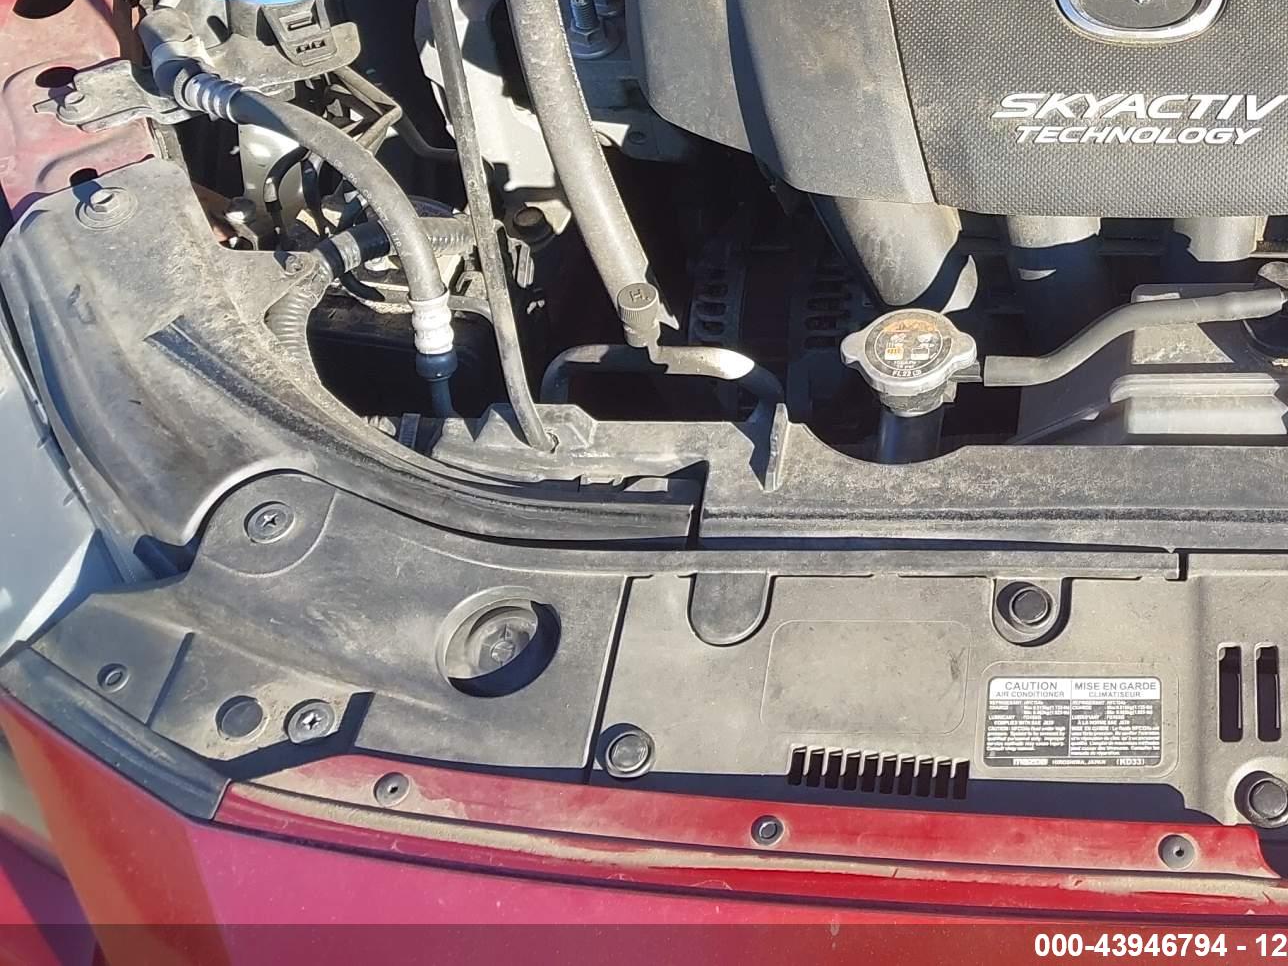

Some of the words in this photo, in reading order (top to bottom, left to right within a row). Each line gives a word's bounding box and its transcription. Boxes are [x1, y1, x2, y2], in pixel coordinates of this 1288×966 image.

[990, 92, 1288, 121] SKYACTIV
[1014, 125, 1262, 145] TECHNOLOGY
[1005, 681, 1058, 691] CAUTION
[1074, 682, 1100, 691] MISE
[1102, 682, 1117, 691] EN
[1119, 682, 1157, 691] GARDE
